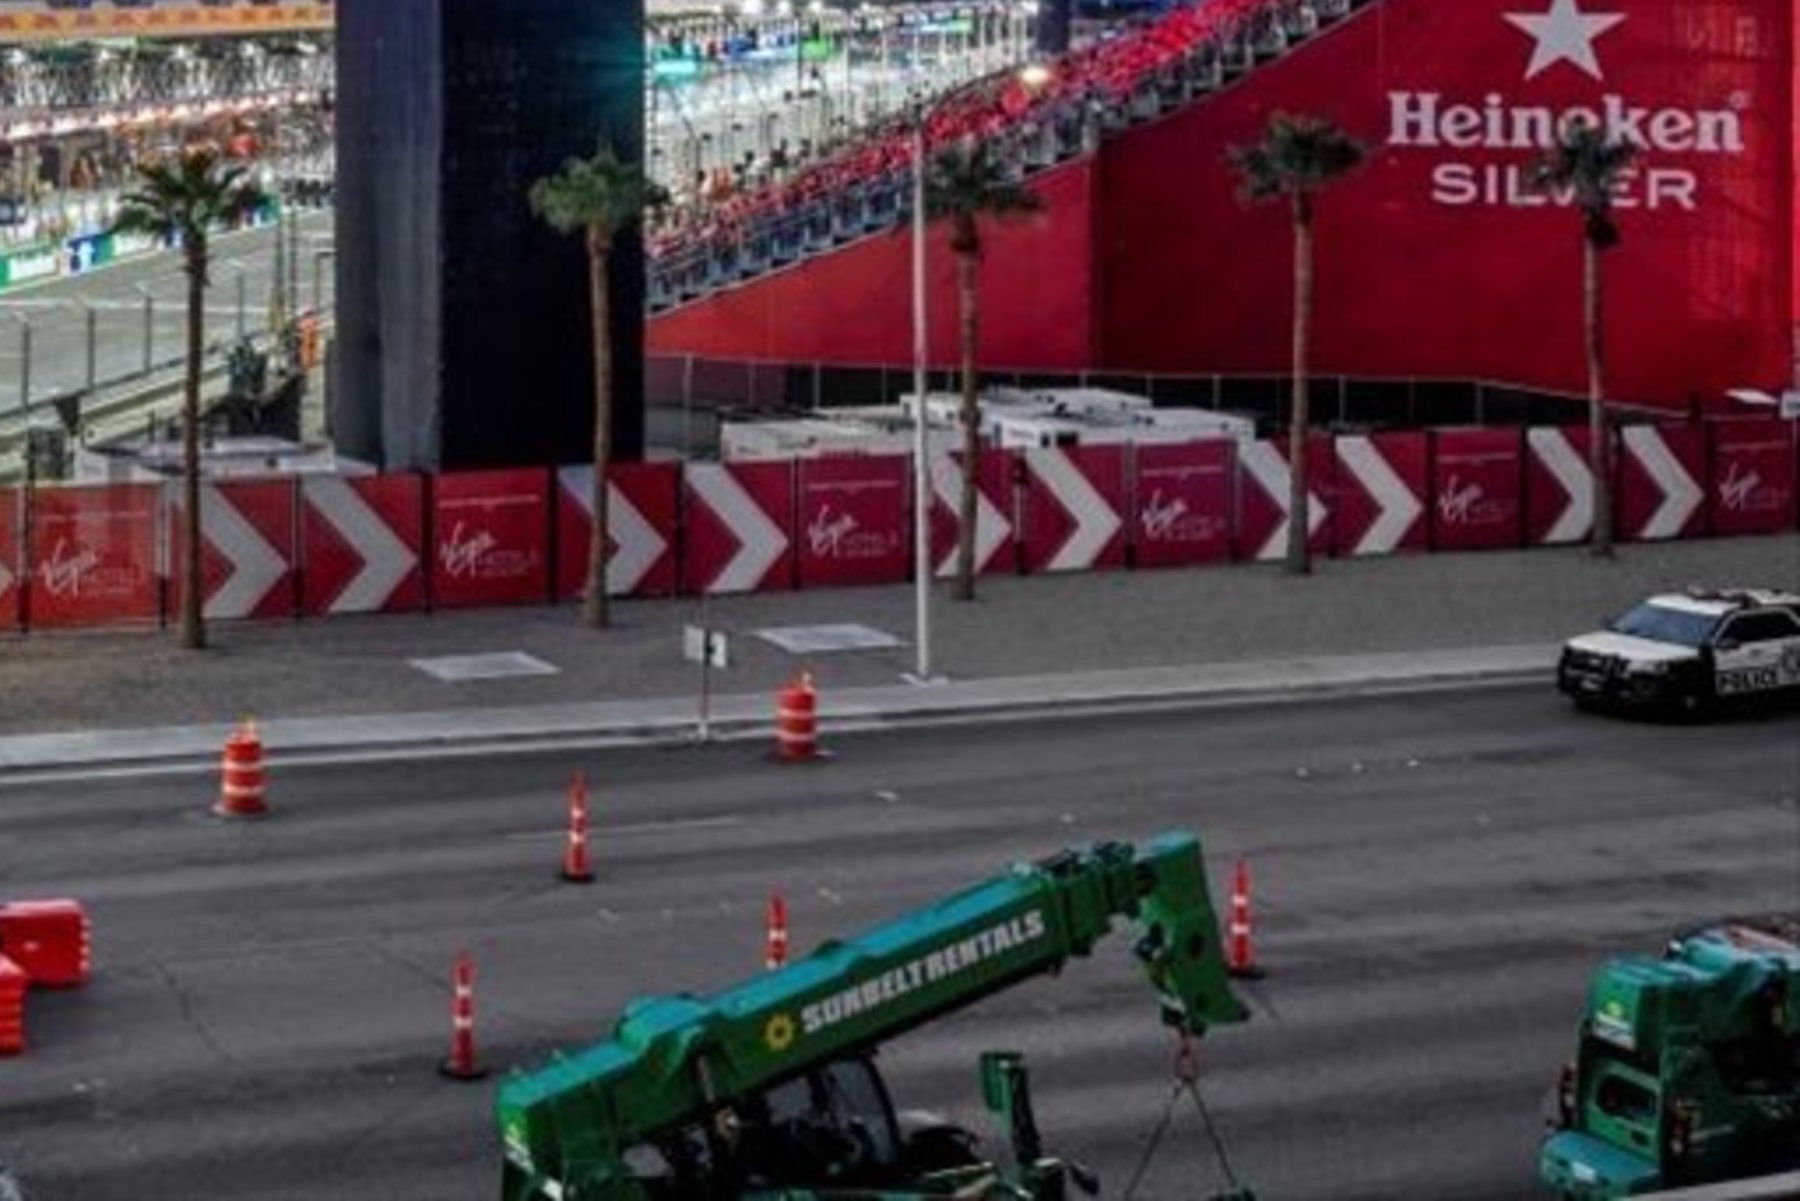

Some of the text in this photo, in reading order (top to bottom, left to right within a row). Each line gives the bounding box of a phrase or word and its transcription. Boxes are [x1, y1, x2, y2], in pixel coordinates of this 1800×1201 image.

[1387, 91, 1744, 151] Heineken
[1718, 664, 1778, 692] POLICE
[801, 909, 1045, 1034] SUNBELT RENTALS
